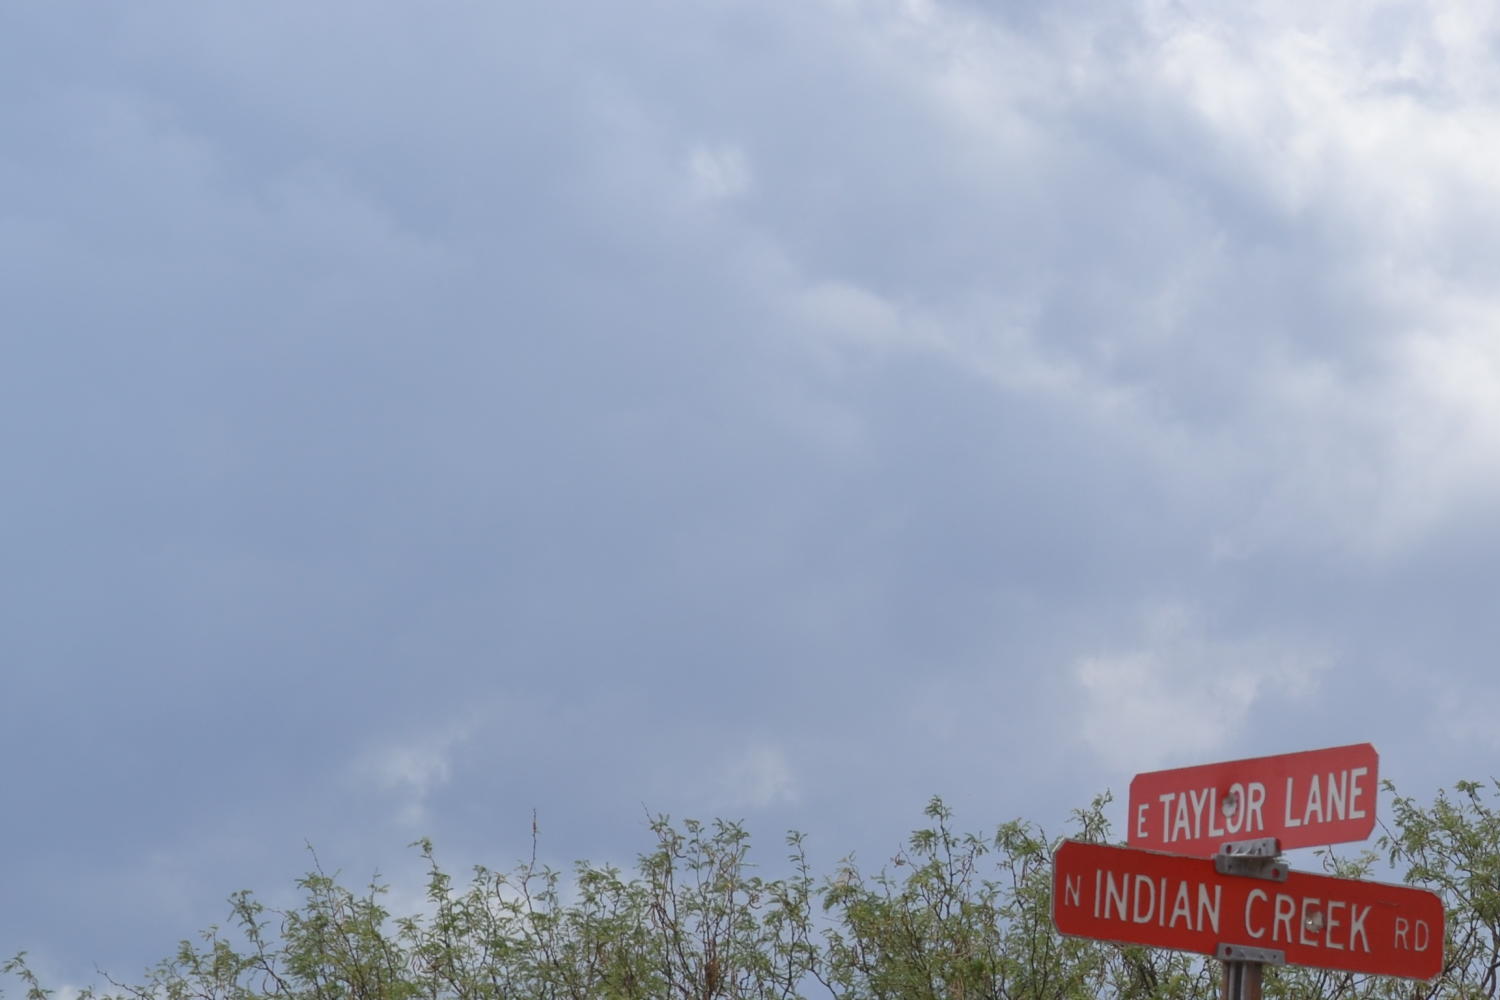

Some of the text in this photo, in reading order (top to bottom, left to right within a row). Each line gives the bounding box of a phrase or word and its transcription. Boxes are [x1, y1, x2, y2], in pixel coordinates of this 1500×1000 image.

[1137, 767, 1367, 843] E TAYLOR LANE
[1065, 869, 1429, 953] N INDIAN CREEK RD
